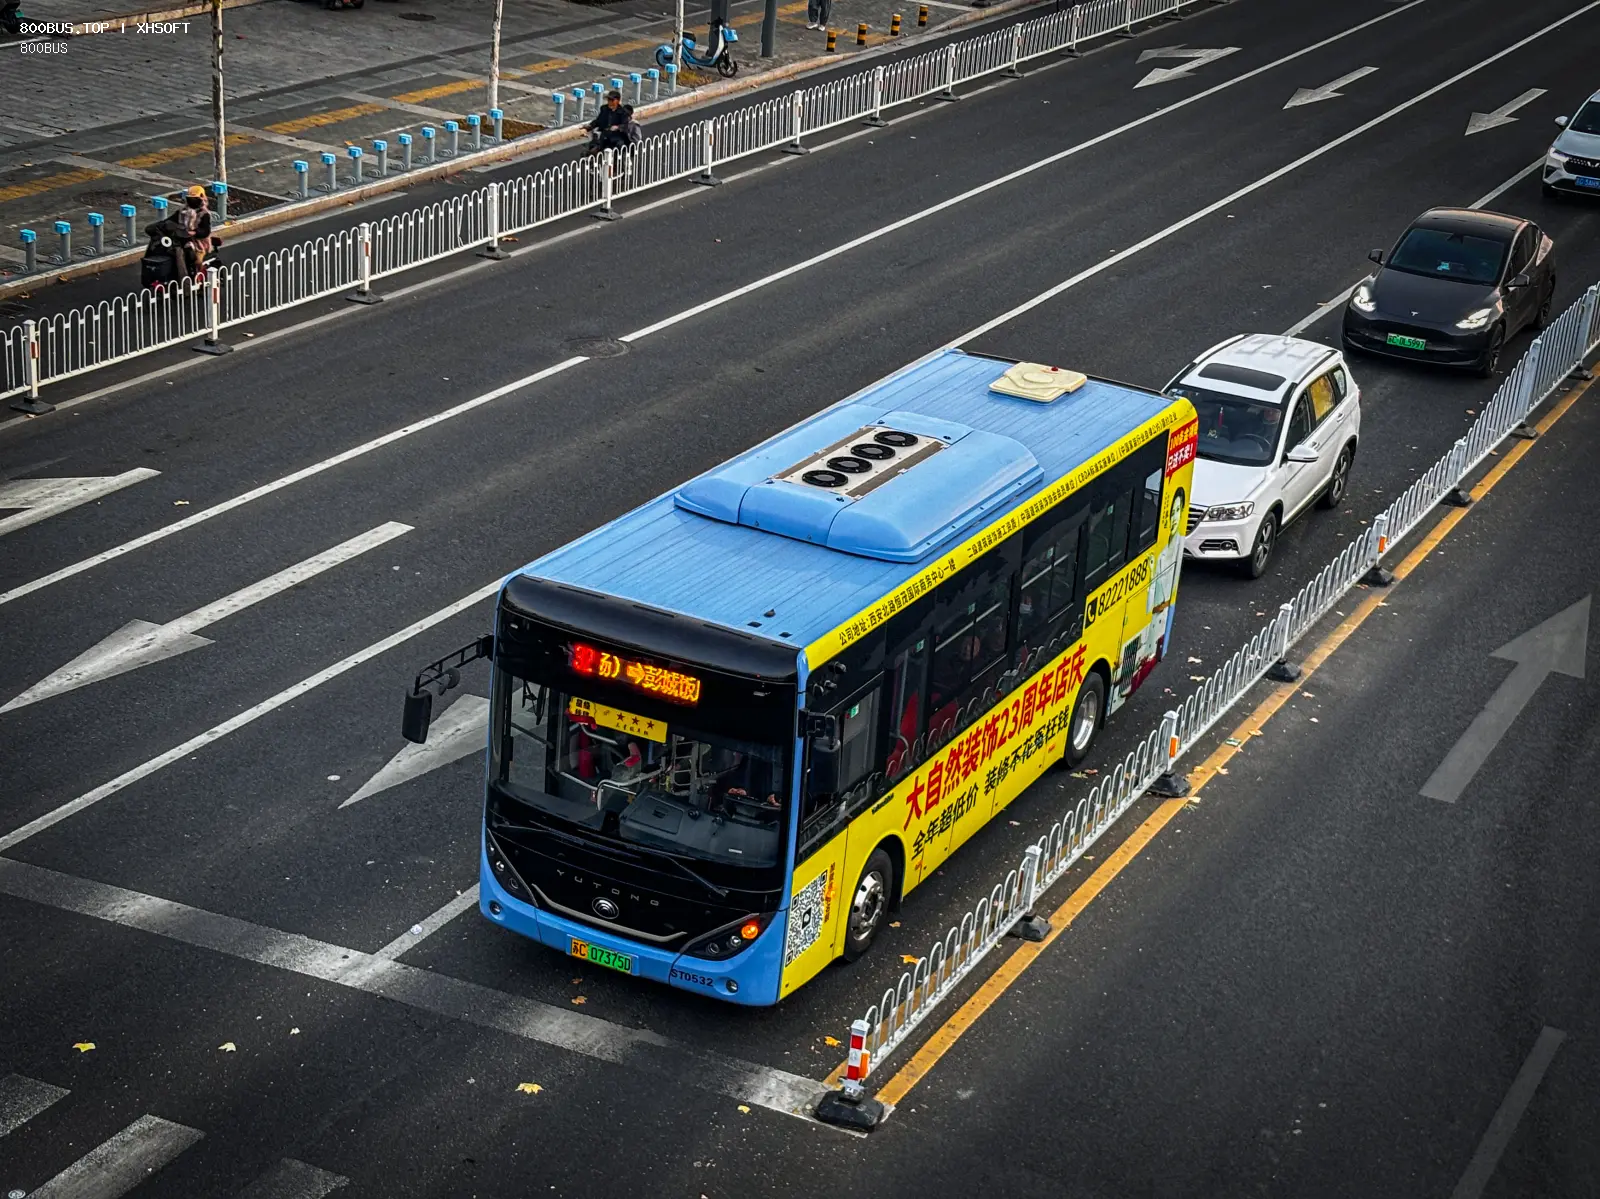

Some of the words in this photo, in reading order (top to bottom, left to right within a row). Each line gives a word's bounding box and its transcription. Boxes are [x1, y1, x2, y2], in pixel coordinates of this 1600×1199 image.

[1097, 558, 1149, 617] 82221888
[642, 665, 701, 702] 彭城饭
[903, 643, 1088, 832] 大自然装饰23周年店庆
[911, 782, 979, 861] 全年超低价
[556, 869, 660, 907] YUTONG
[670, 968, 714, 988] ST0532
